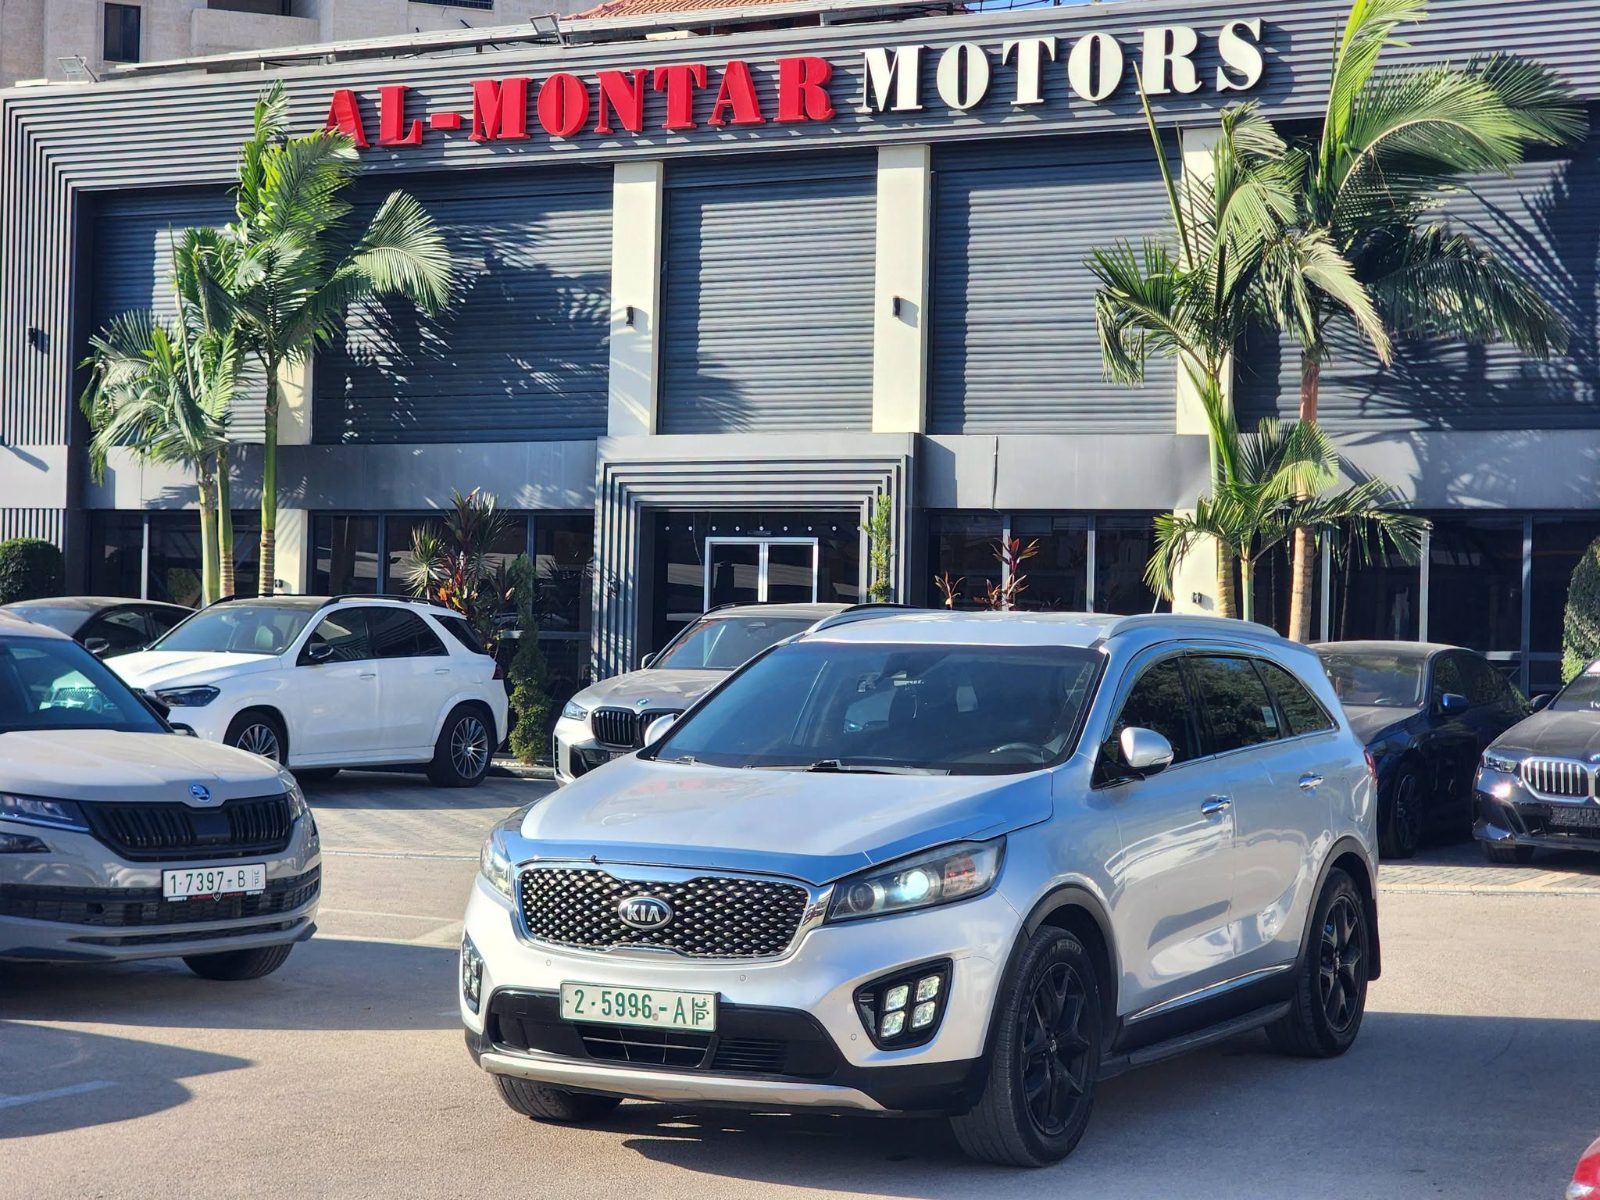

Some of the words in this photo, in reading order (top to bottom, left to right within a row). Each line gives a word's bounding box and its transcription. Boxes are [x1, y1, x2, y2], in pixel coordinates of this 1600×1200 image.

[324, 56, 838, 149] AL-MONTAR
[856, 17, 1266, 114] MOTORS
[626, 904, 661, 922] KIA
